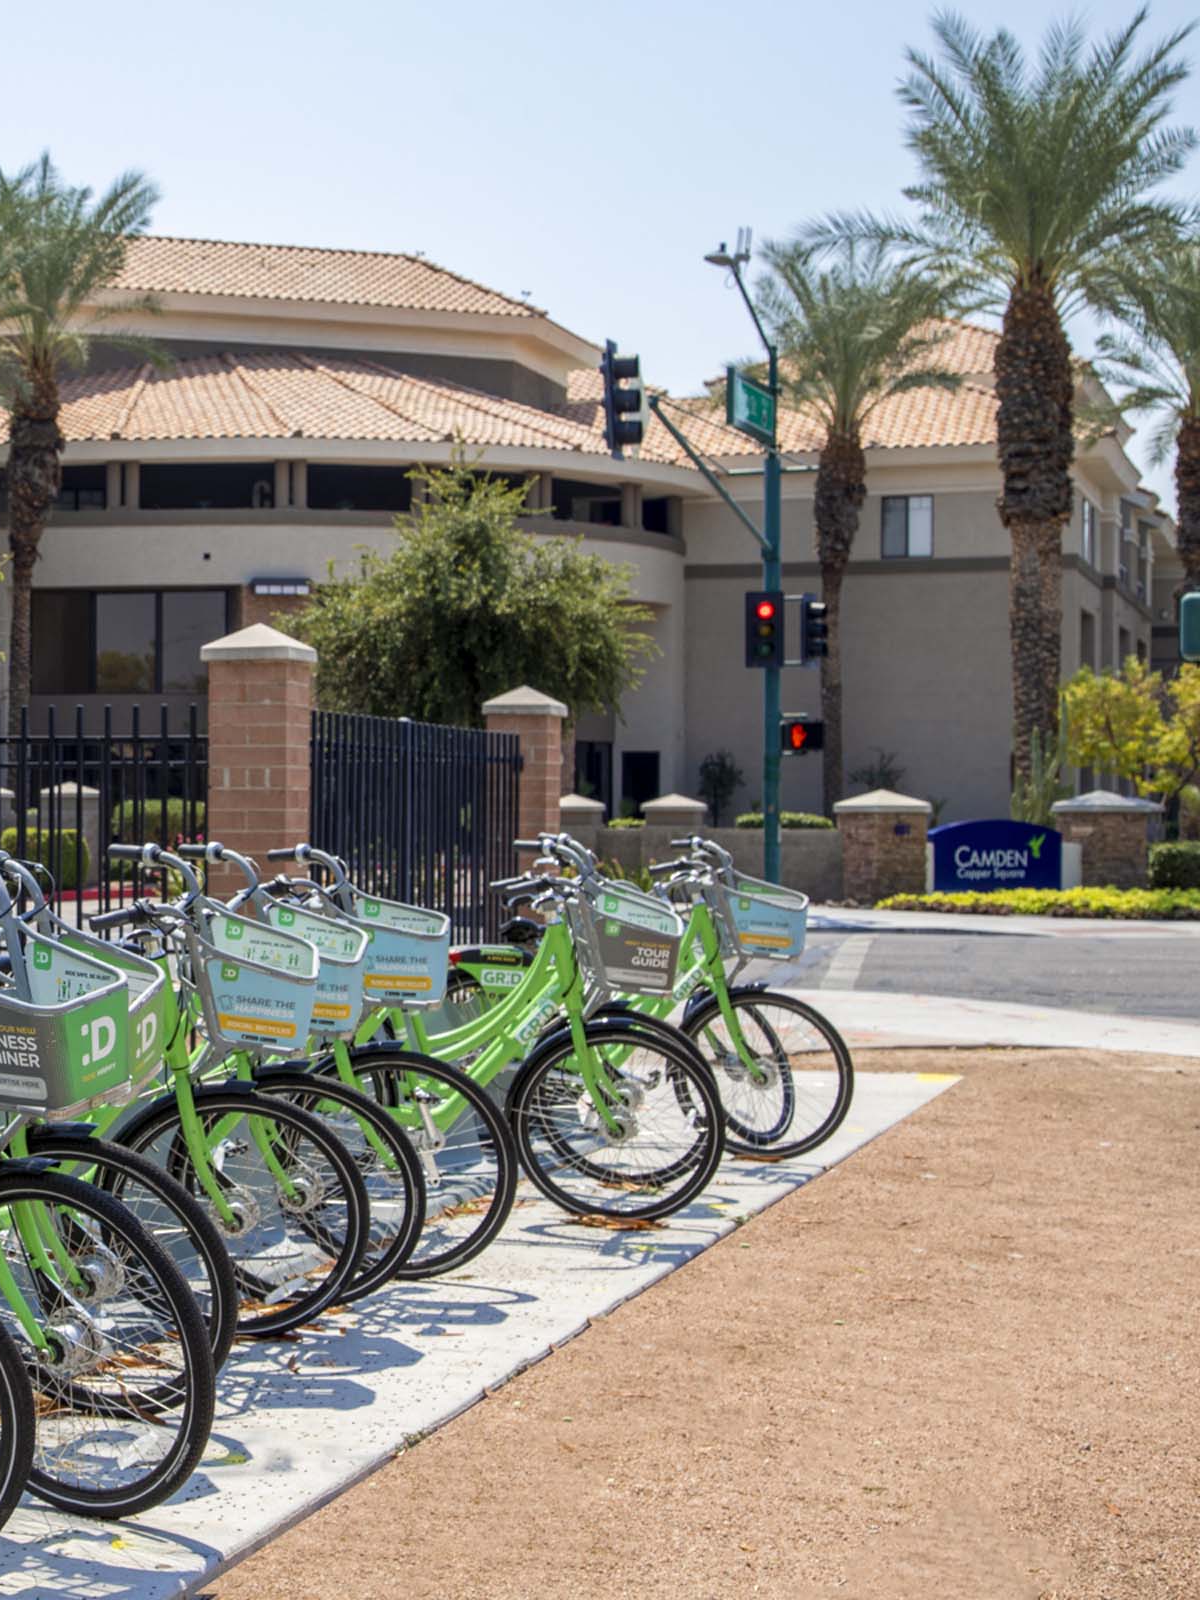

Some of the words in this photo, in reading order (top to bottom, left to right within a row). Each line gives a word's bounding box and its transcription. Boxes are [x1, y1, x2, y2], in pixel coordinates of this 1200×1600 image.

[954, 845, 1029, 868] CAMDEN
[956, 868, 992, 881] Copper
[993, 867, 1027, 881] Square
[637, 947, 671, 959] TOUR
[631, 956, 669, 969] GUIDE
[236, 994, 273, 1008] SHARE
[274, 999, 297, 1011] THE
[16, 1026, 37, 1036] NEW
